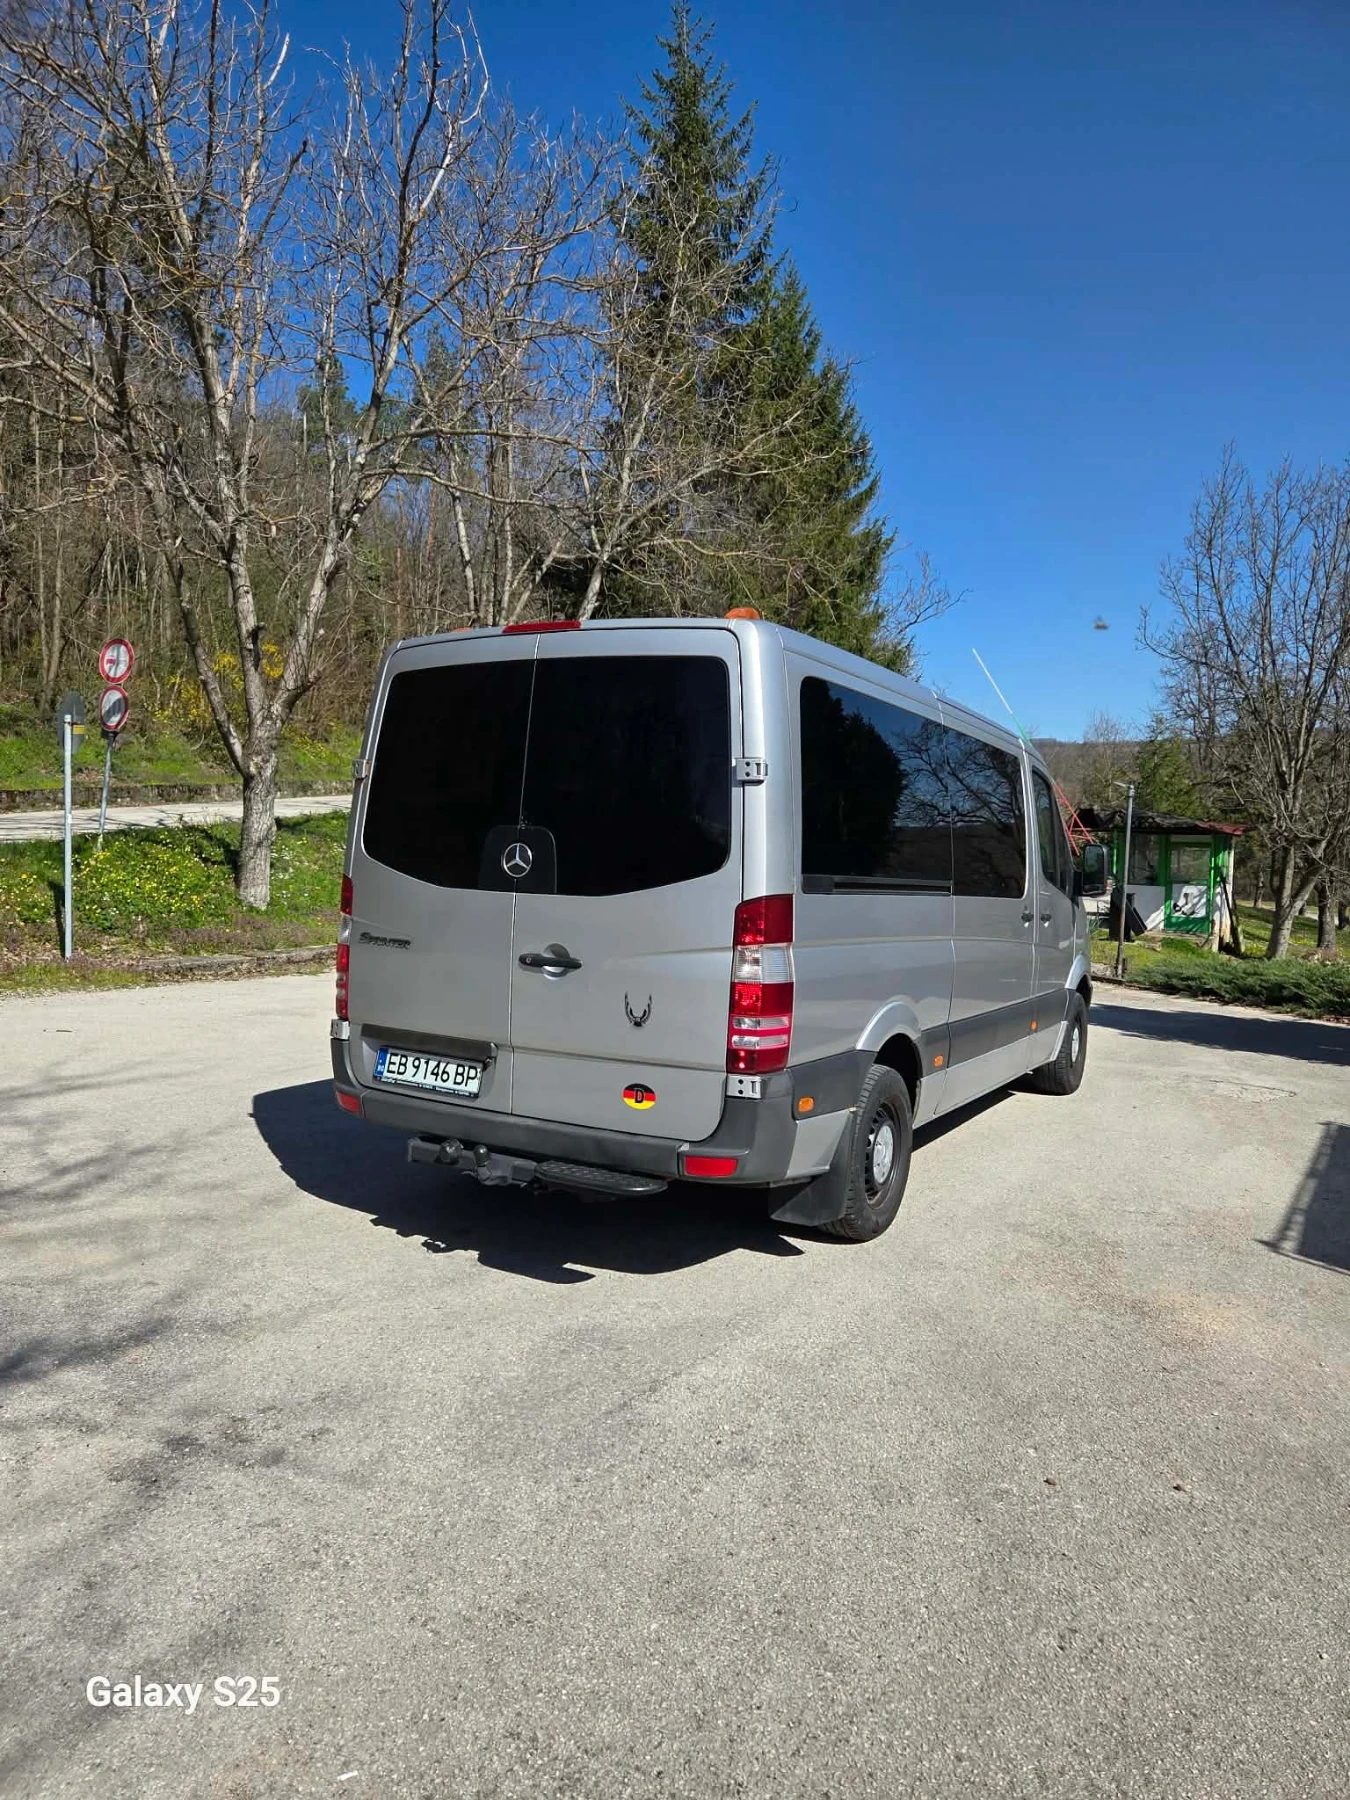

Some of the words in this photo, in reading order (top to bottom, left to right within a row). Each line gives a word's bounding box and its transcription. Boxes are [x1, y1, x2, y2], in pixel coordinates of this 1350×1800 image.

[386, 1053, 408, 1075] EB
[411, 1057, 450, 1083] 9146
[453, 1063, 478, 1087] BP
[634, 1088, 645, 1104] D
